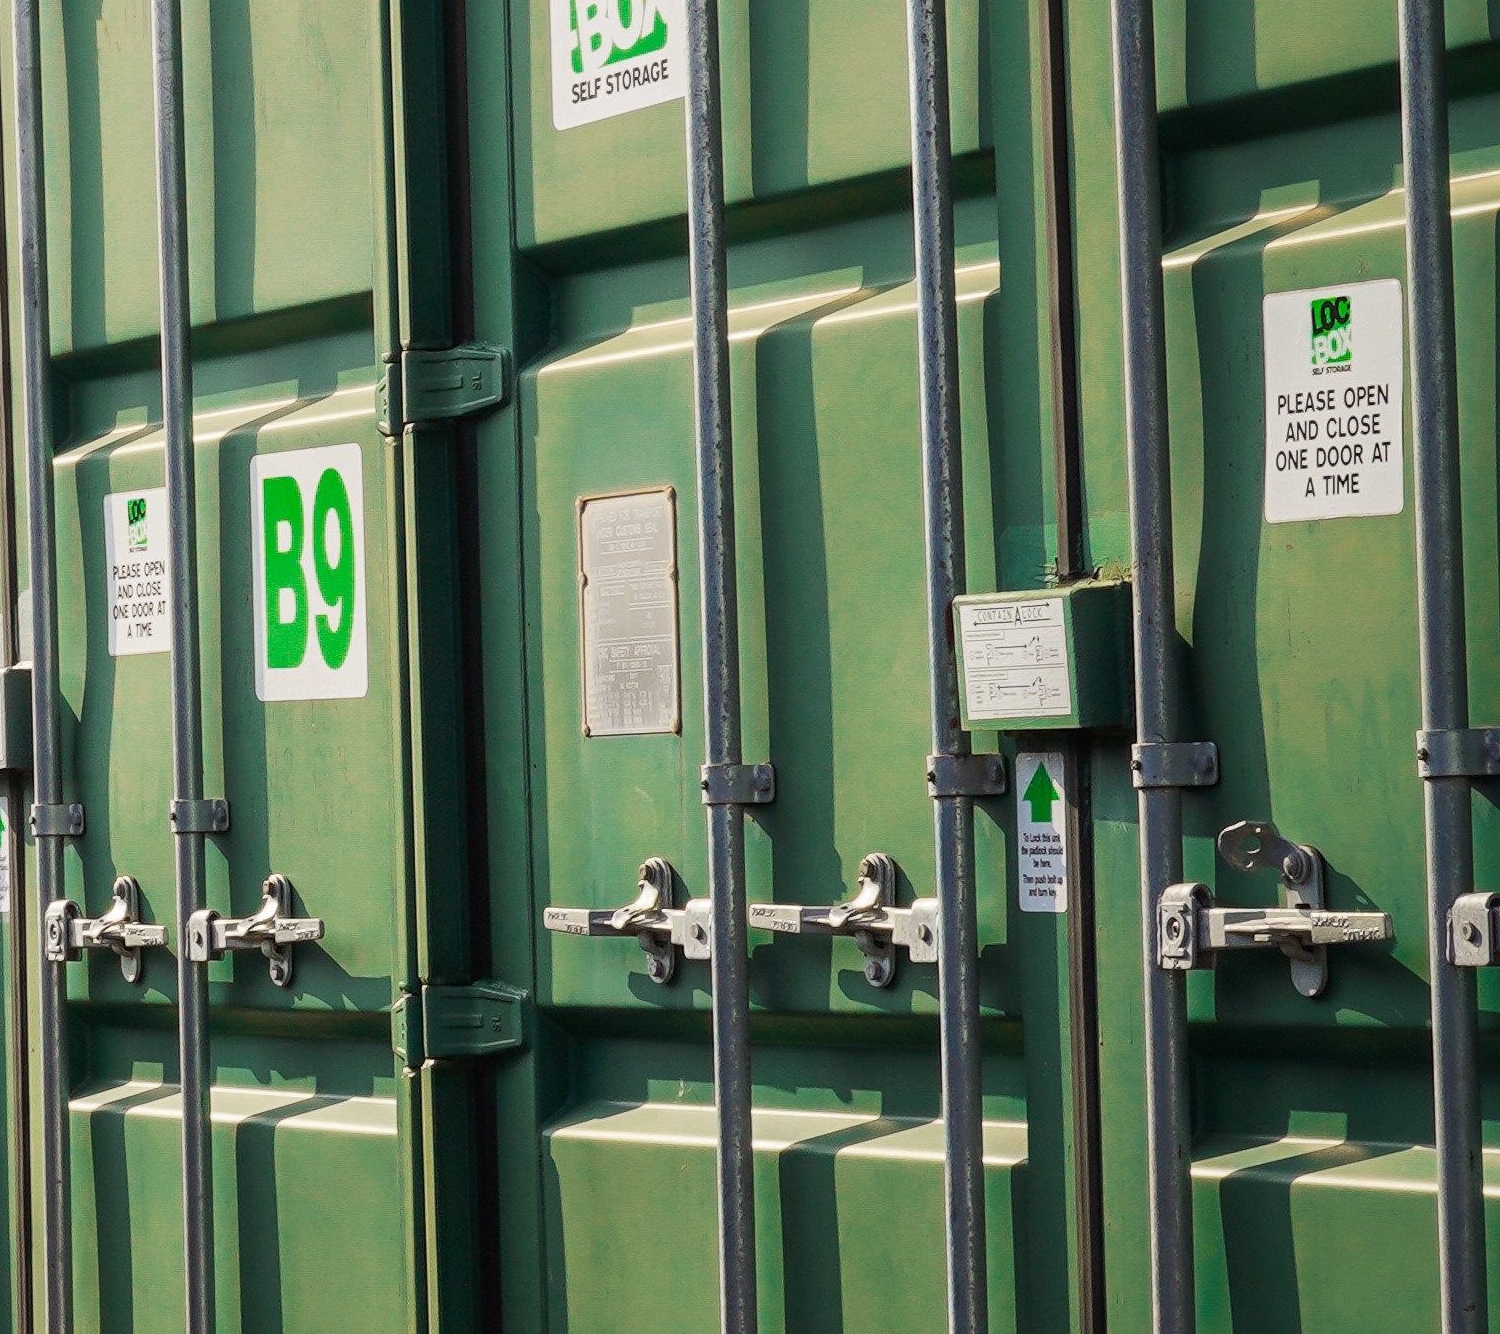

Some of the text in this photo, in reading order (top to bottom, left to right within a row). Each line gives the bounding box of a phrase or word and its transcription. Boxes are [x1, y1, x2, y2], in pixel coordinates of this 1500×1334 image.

[572, 59, 669, 104] SELF STORAGE
[1278, 384, 1389, 415] PLEASE OPEN
[1285, 414, 1381, 443] AND CLOSE
[1275, 441, 1391, 472] ONE DOOR AT
[1305, 473, 1360, 498] A TIME
[113, 560, 165, 581] PLEASE OPEN
[263, 468, 355, 670] B9
[117, 581, 162, 599] AND CLOSE
[113, 601, 166, 620] ONE DOOR AT
[977, 606, 1043, 626] CONTAIN A LOCK
[127, 622, 152, 638] A TIME
